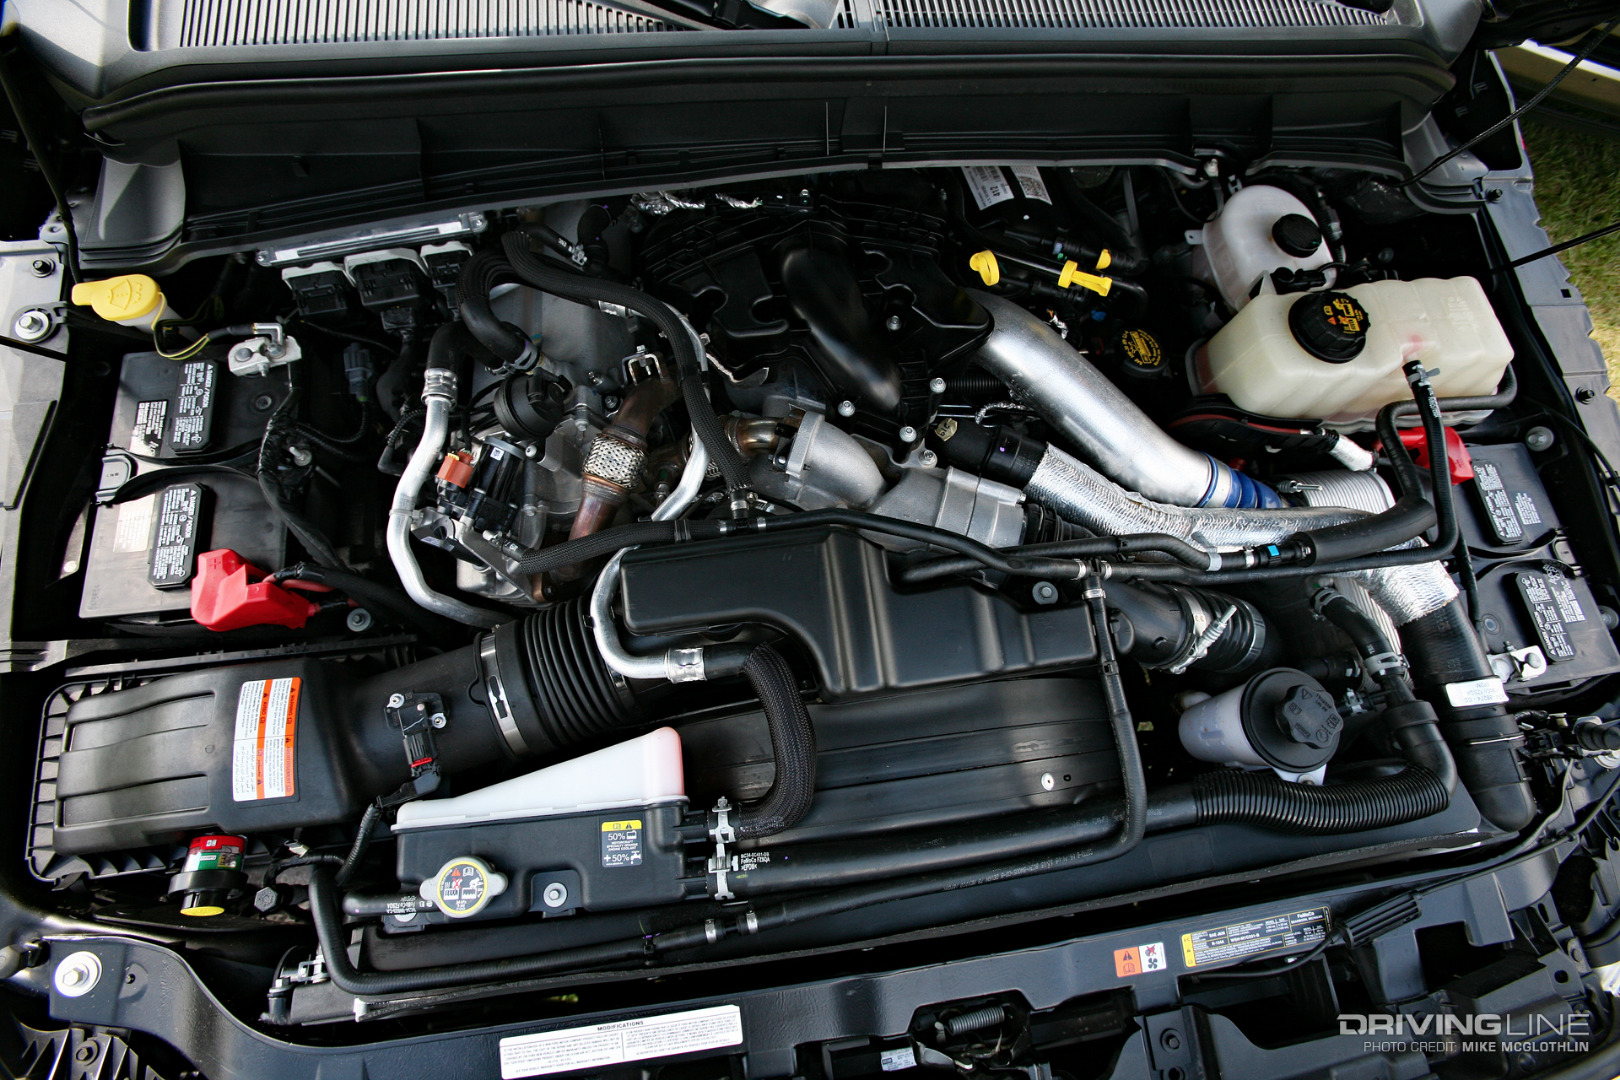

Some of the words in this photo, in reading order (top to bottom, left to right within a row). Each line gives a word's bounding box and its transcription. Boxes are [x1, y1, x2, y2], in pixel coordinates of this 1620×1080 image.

[205, 370, 214, 389] DANGER
[188, 496, 198, 515] DANGER
[184, 520, 193, 538] POISON
[607, 832, 626, 841] 50%
[596, 1020, 644, 1032] MODIFICATIONS
